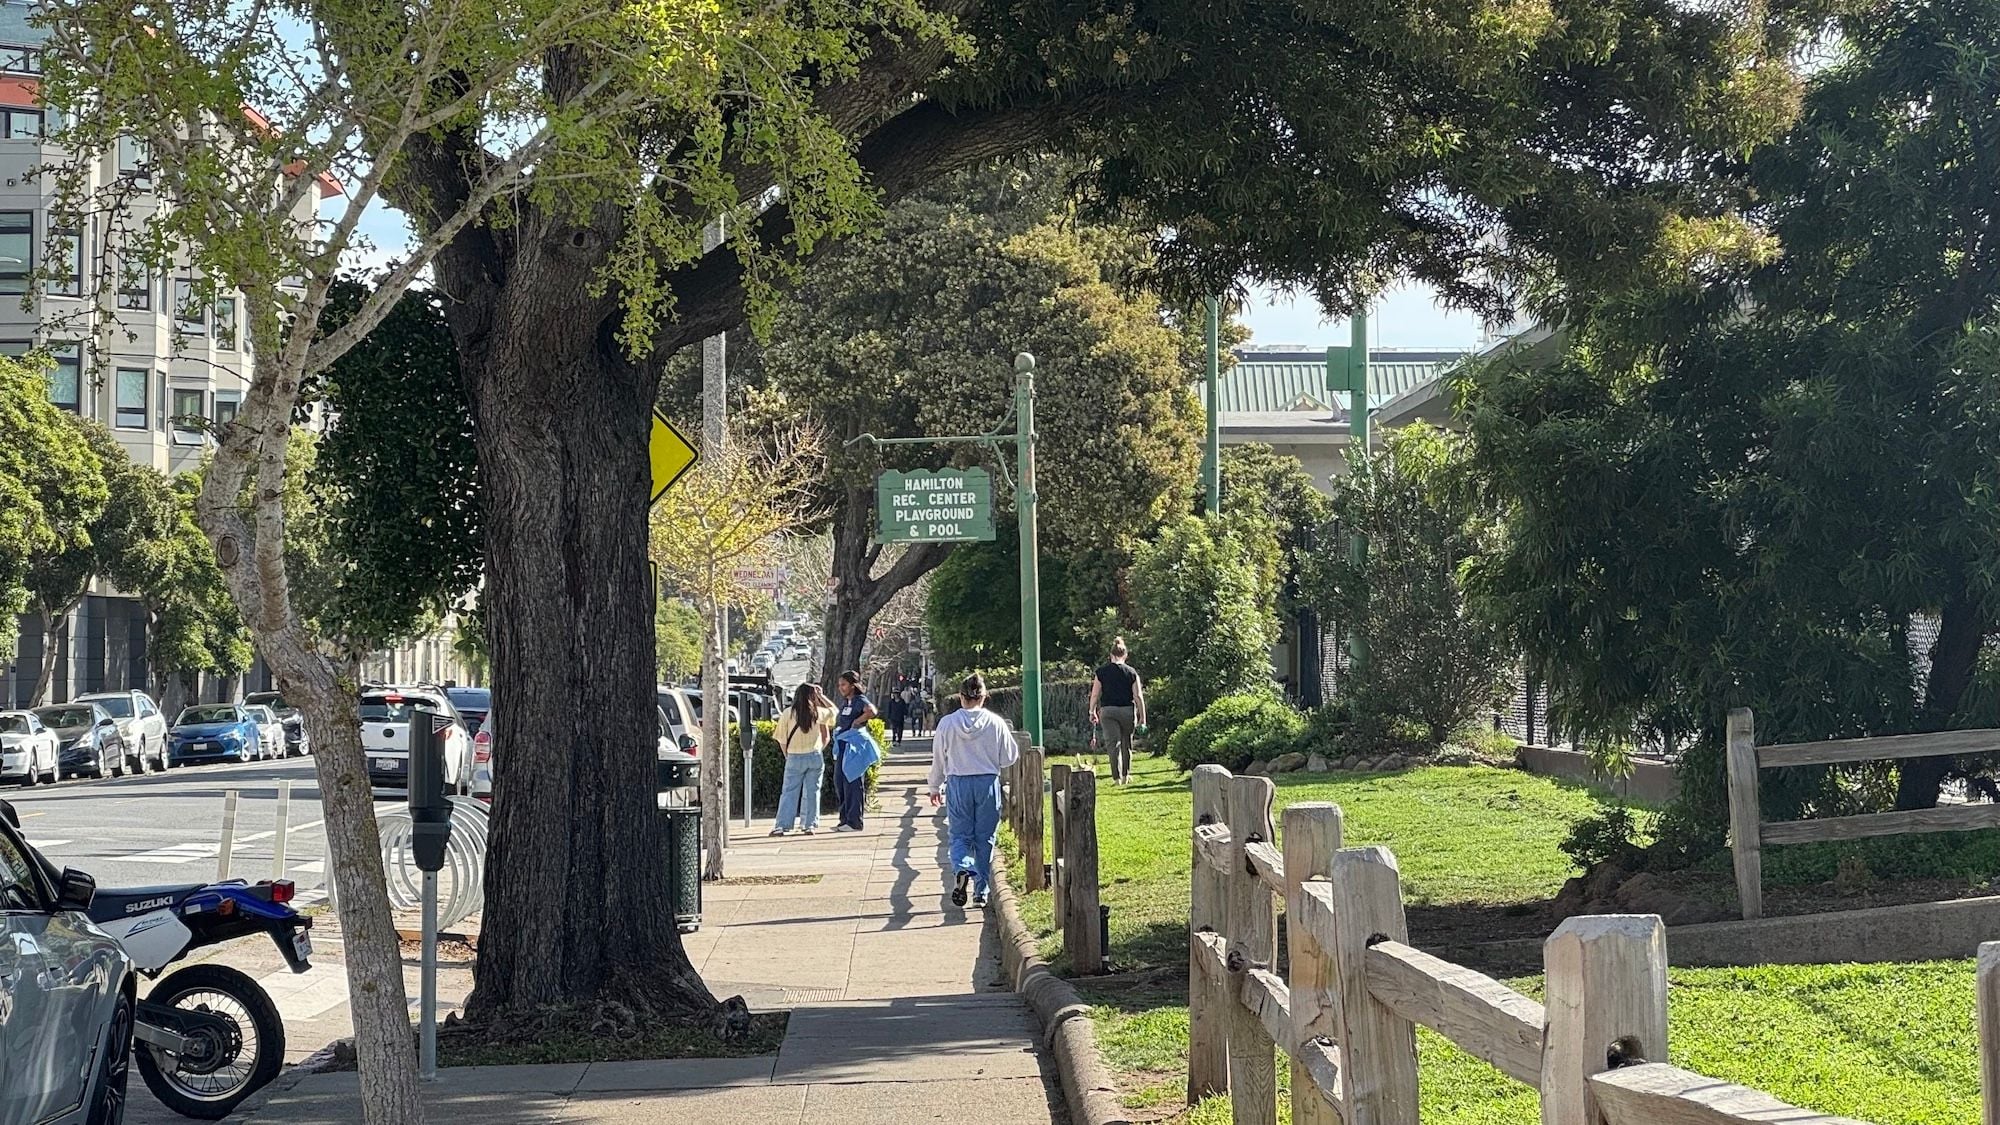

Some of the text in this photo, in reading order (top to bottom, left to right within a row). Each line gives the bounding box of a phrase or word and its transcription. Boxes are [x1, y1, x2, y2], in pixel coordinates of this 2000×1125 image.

[905, 478, 963, 491] HAMILTON
[893, 493, 976, 506] REC. CENTER
[895, 508, 974, 522] PLAYGROUND
[910, 524, 962, 537] & POOL
[125, 896, 173, 913] SUZUKI
